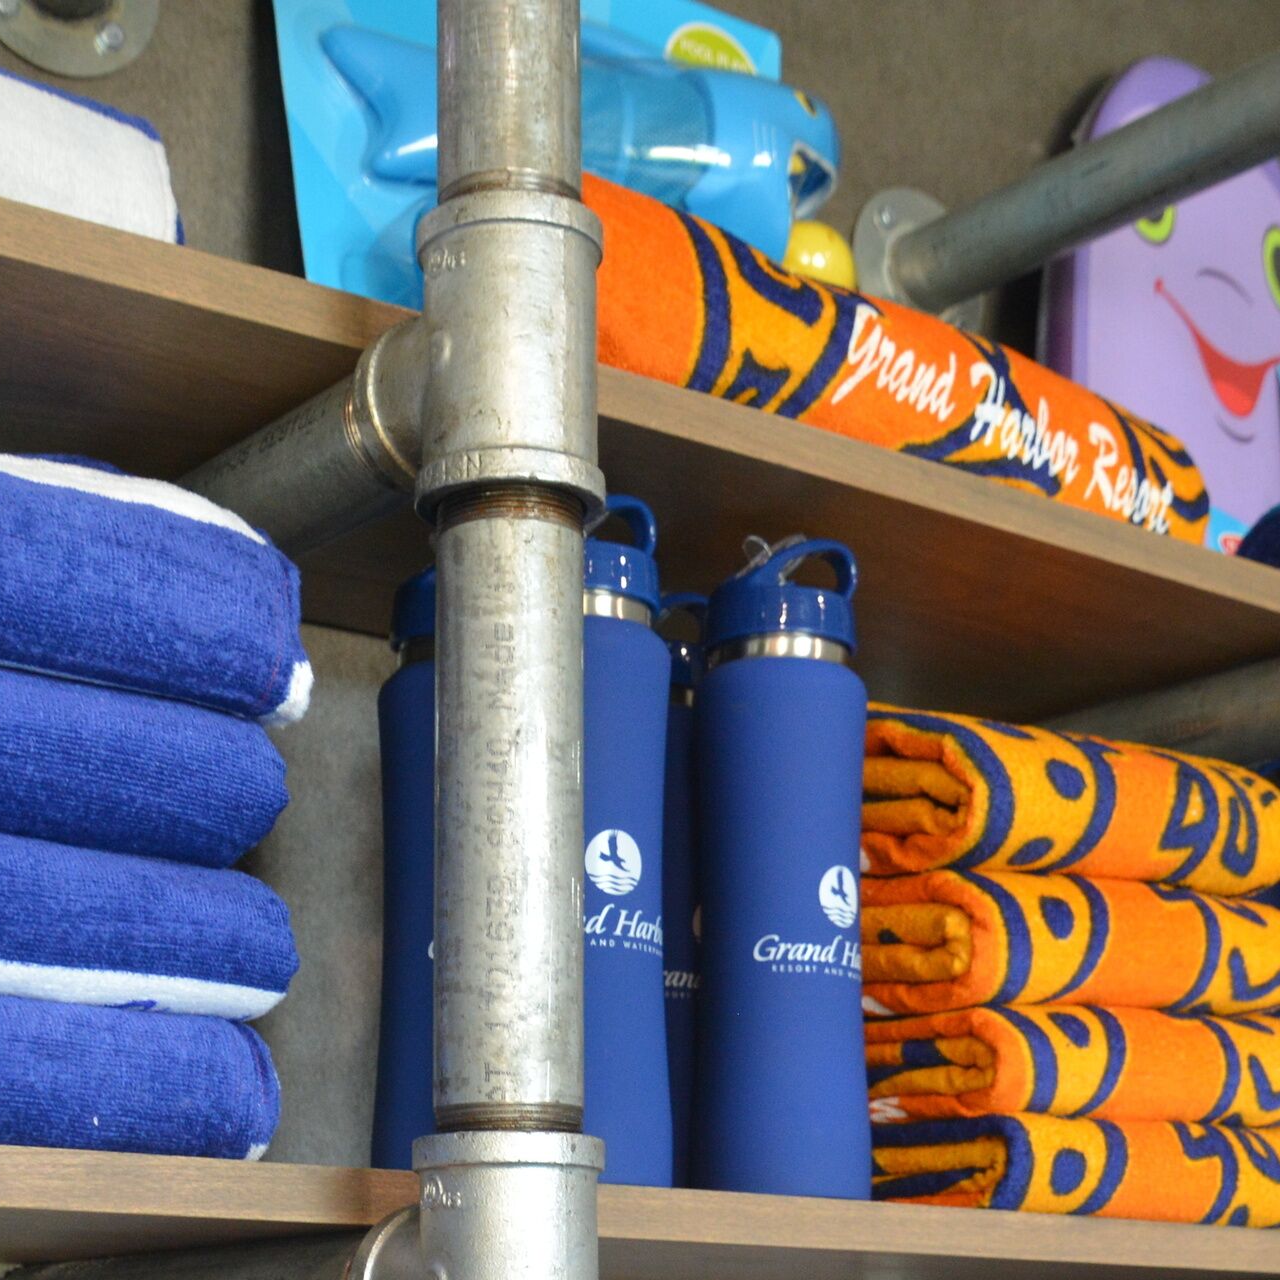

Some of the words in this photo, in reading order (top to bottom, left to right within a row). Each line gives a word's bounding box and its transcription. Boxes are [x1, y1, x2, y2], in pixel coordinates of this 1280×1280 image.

[832, 303, 957, 423] Grand
[969, 361, 1081, 484] Harbor
[1083, 421, 1175, 535] Resort
[753, 934, 843, 964] Grand
